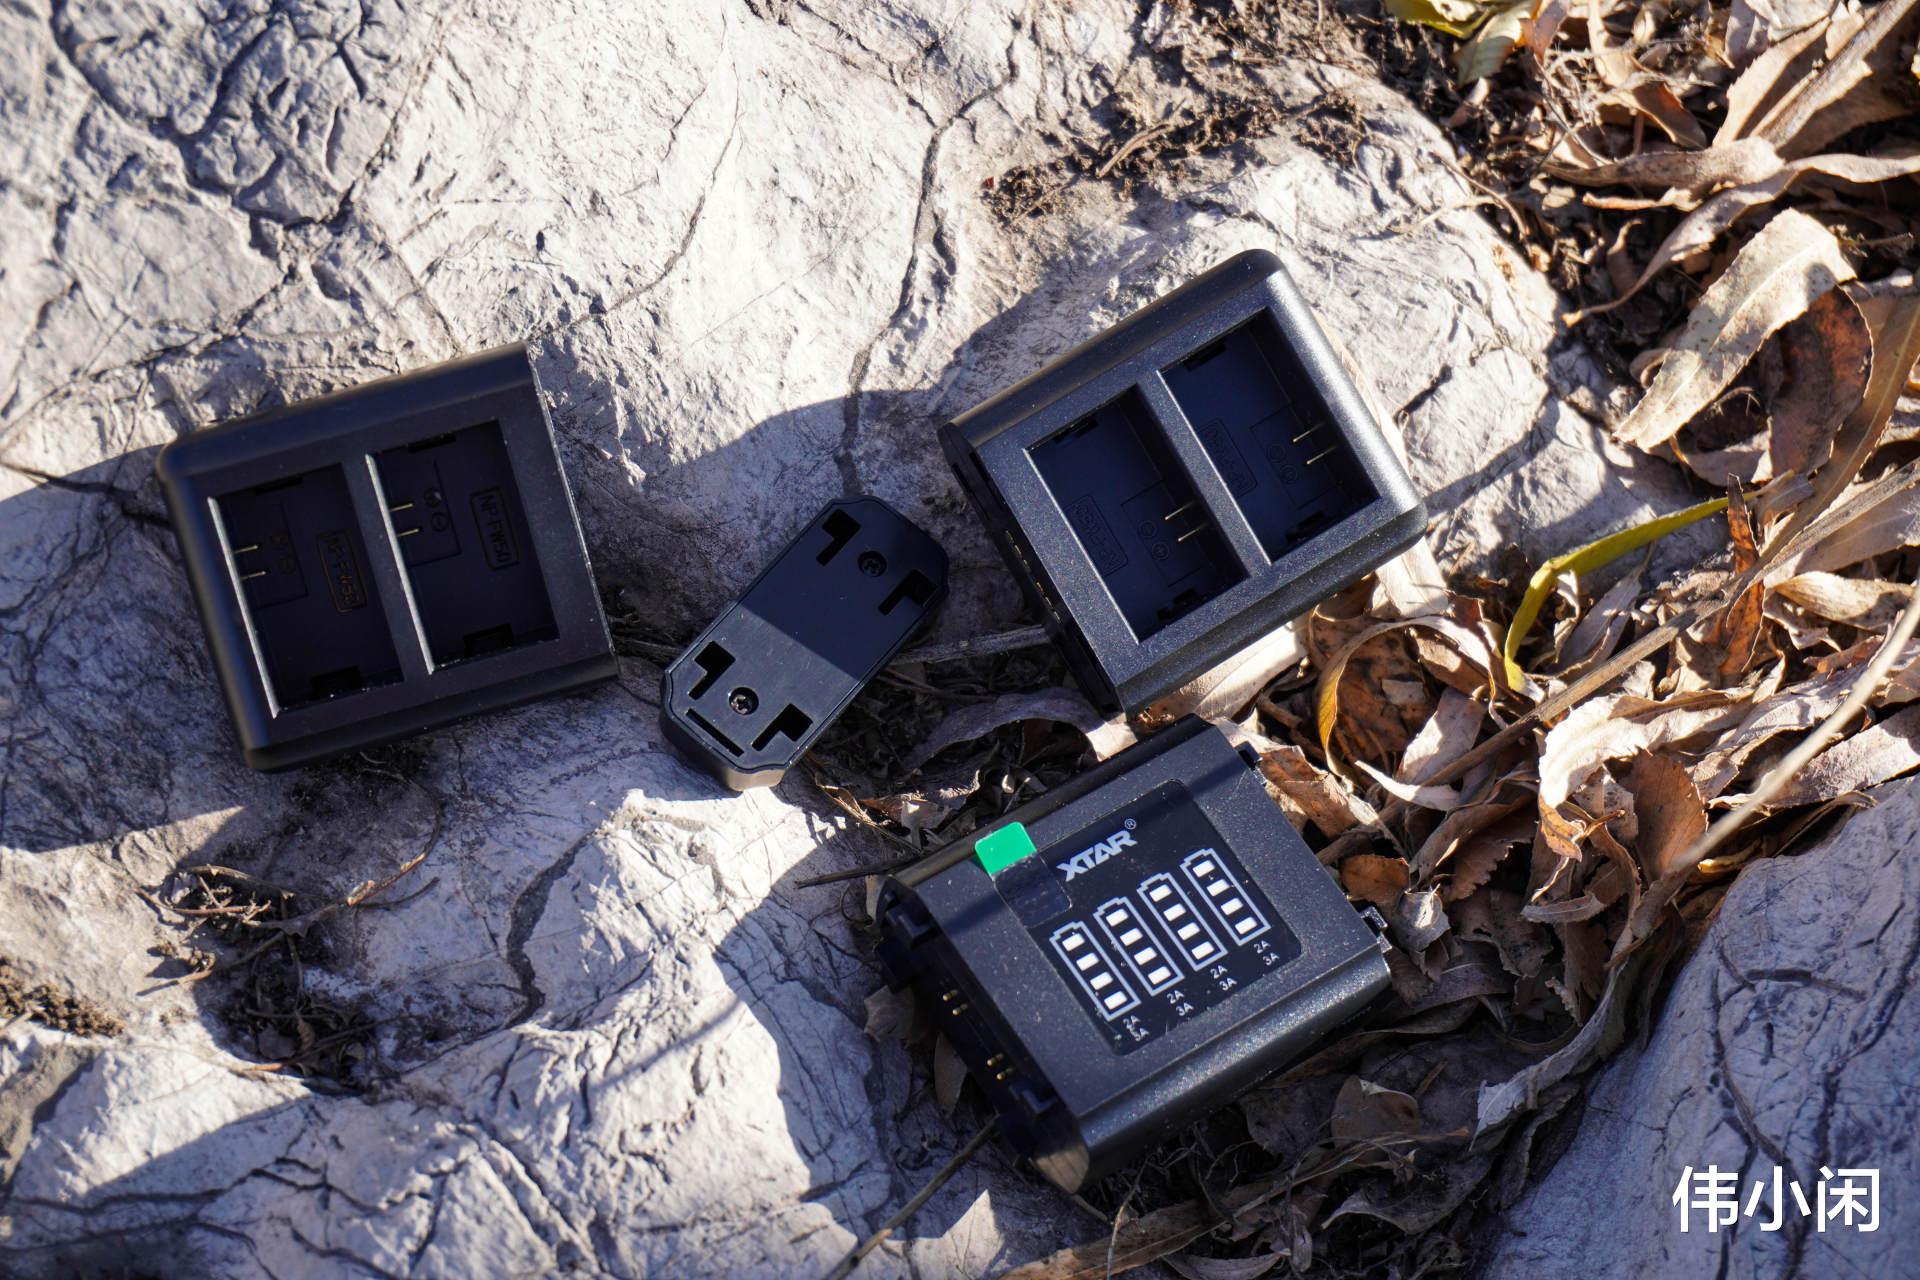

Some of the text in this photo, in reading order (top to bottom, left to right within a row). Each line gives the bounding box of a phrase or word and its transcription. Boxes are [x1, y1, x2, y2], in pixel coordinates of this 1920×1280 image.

[1253, 940, 1271, 955] 2A
[1261, 952, 1280, 967] 3A
[1210, 964, 1229, 980] 2A
[1219, 976, 1238, 992] 3A
[1166, 989, 1185, 1005] 2A
[1175, 1001, 1195, 1018] 3A
